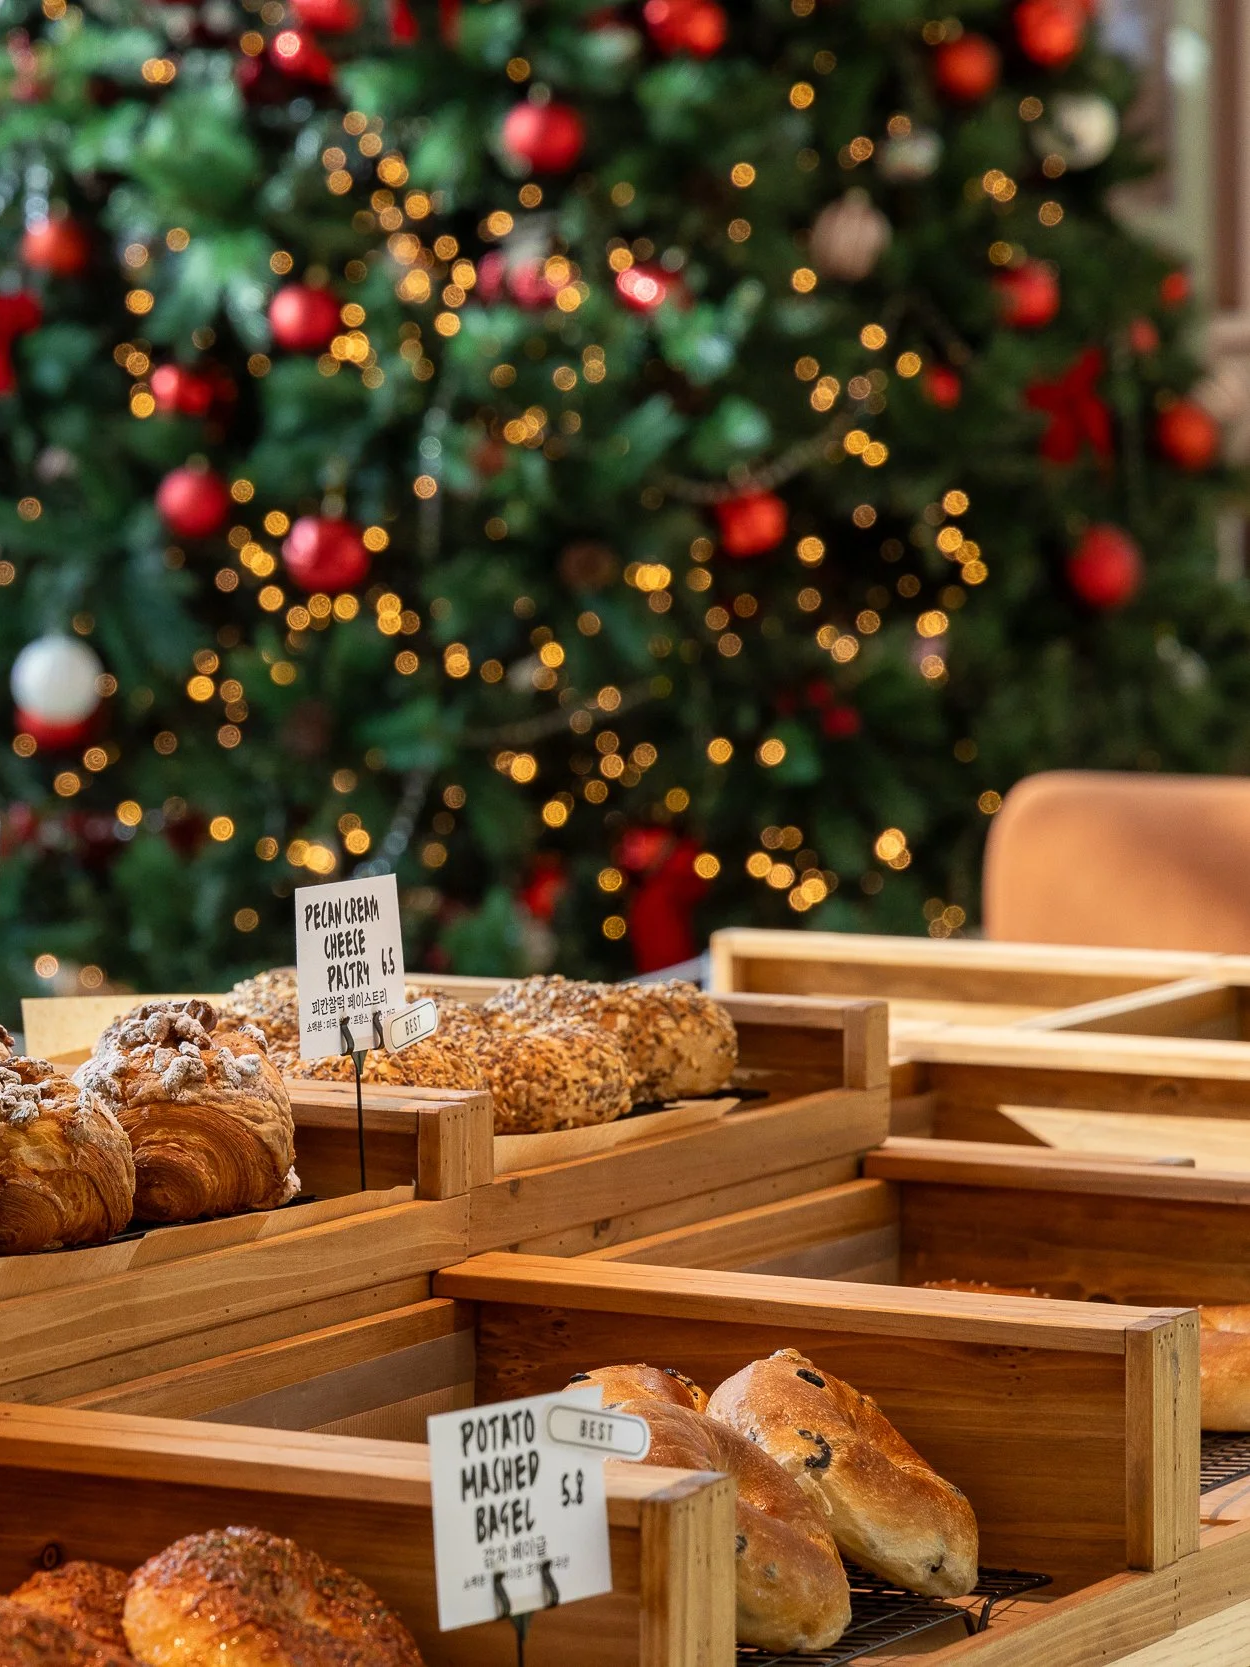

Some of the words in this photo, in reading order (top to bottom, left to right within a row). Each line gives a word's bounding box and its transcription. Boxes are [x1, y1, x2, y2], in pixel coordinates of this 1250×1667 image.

[304, 898, 341, 931] PECAN
[344, 894, 380, 925] CREAM
[324, 928, 366, 960] CHEESE
[327, 960, 370, 992] PASTRY
[381, 947, 395, 976] 6.5
[347, 988, 388, 1011] 페이스트리
[405, 1014, 422, 1036] BEST
[460, 1408, 536, 1457] POTATO
[579, 1419, 614, 1441] BEST
[460, 1450, 539, 1501] MASHED
[561, 1468, 584, 1508] 5.8
[475, 1498, 535, 1545] BAGEL
